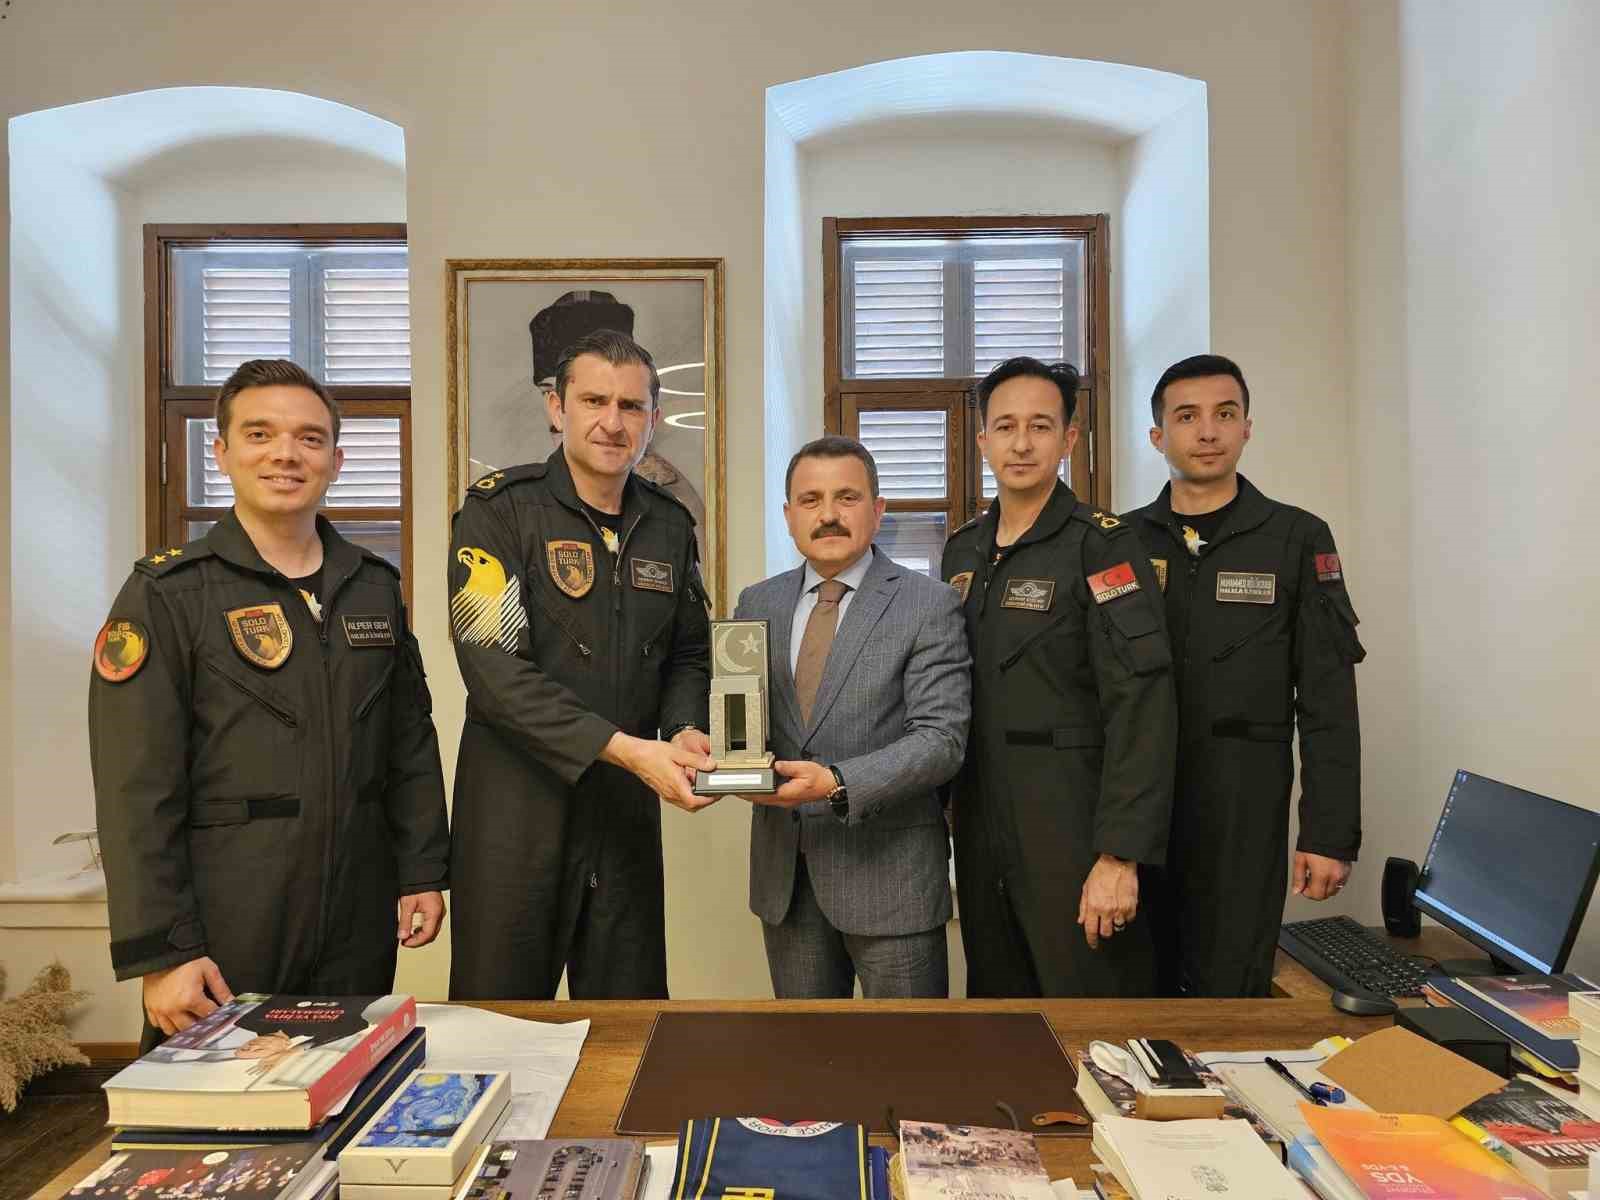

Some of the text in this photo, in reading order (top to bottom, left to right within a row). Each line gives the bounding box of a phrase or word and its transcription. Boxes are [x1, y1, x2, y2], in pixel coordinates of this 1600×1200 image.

[240, 617, 266, 627] SOLO
[748, 1119, 789, 1136] SPOR
[384, 1158, 409, 1174] V
[1369, 1172, 1424, 1184] YDS
